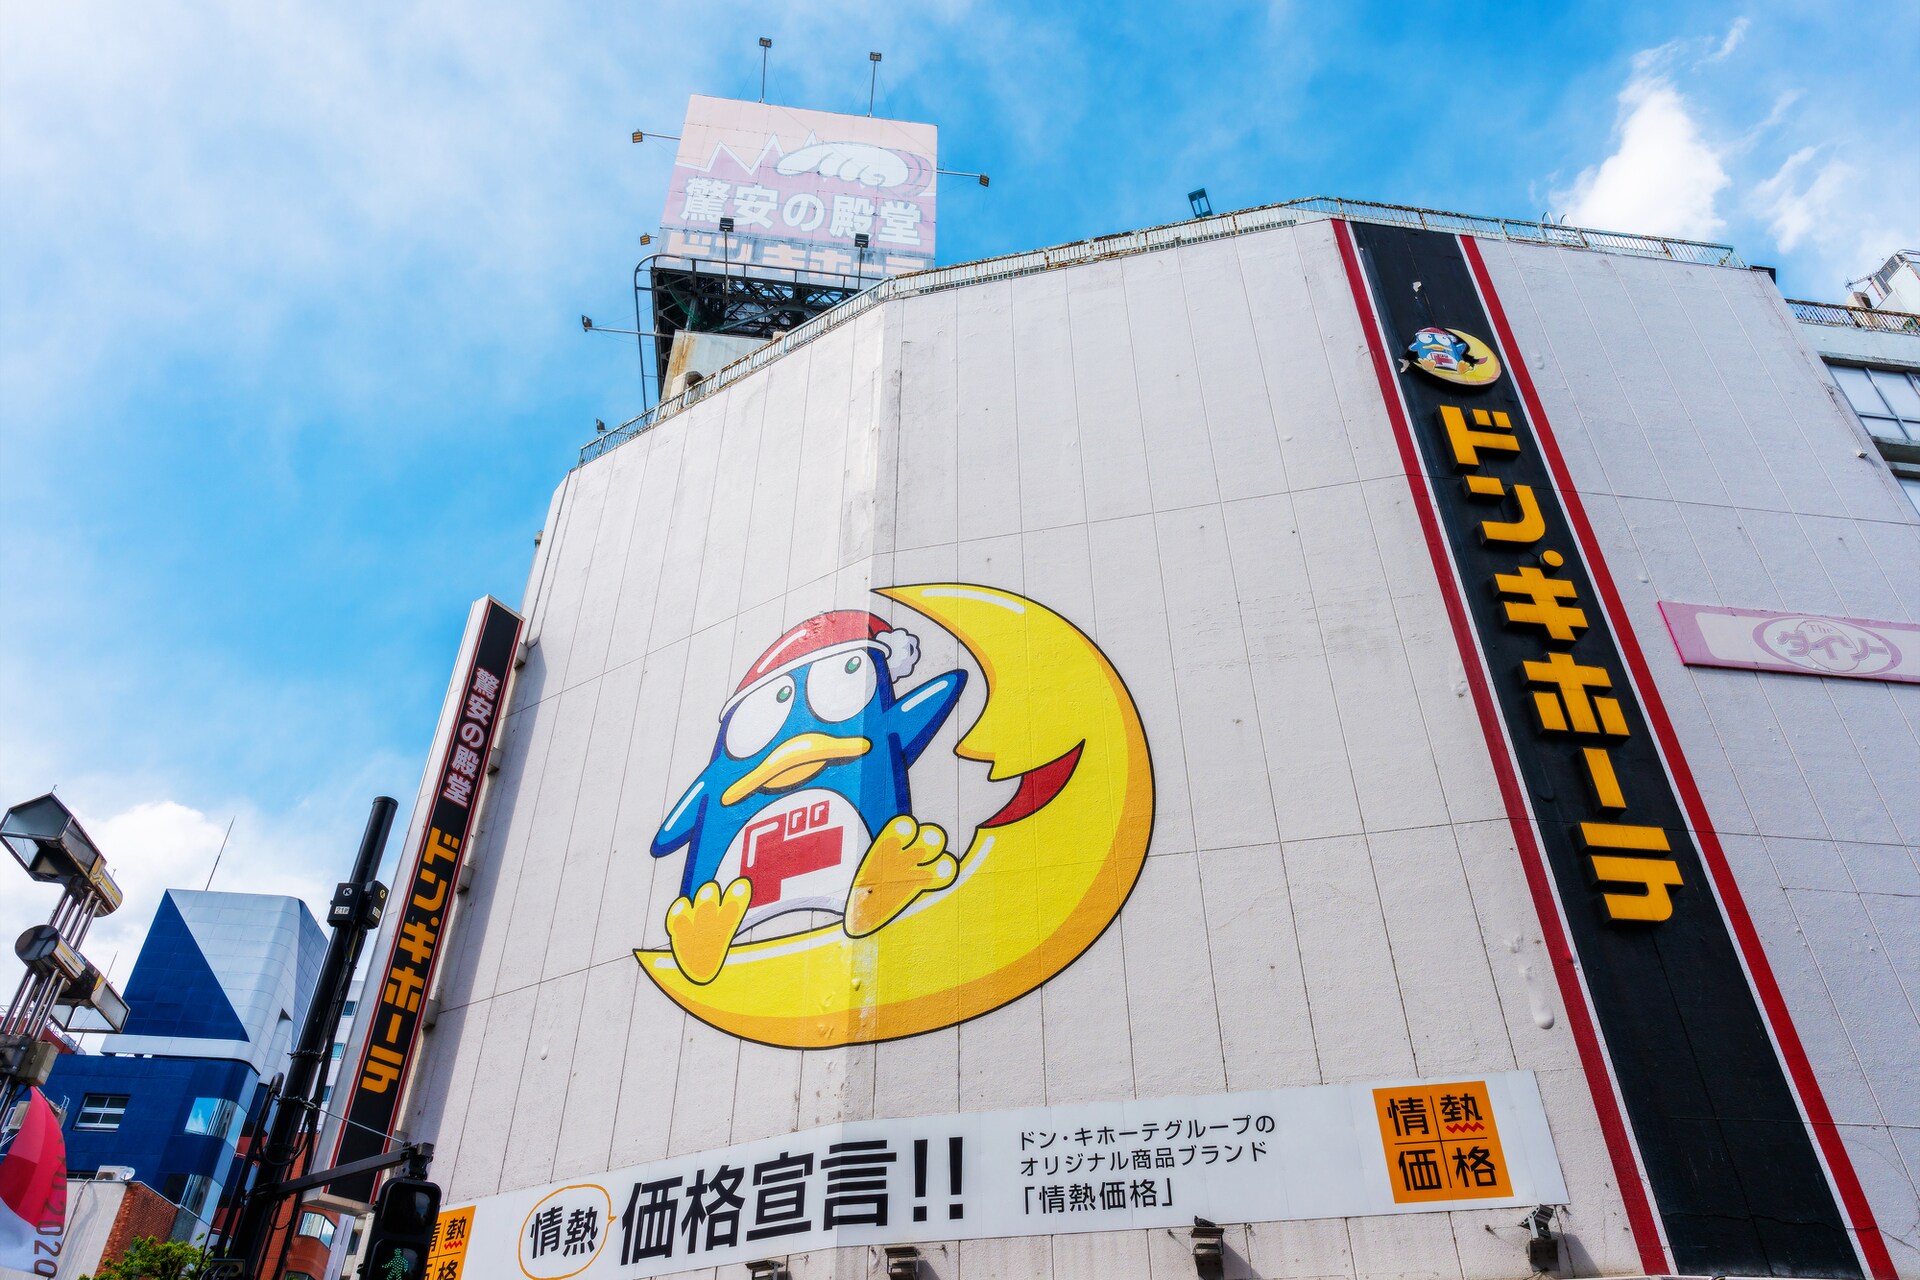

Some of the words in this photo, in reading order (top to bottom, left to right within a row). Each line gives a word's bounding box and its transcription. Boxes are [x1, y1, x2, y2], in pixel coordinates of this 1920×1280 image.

[680, 176, 922, 246] 驚安の殿堂
[1807, 623, 1834, 635] The
[1437, 403, 1685, 923] ドン・キホーテ
[441, 666, 500, 809] 驚安の殿堂
[360, 826, 461, 1094] ドン・キホーテ
[1020, 1114, 1276, 1151] ドン・キホーテグループの
[1386, 1092, 1485, 1137] 情熱
[1020, 1141, 1268, 1177] オリジナル商品ブランド
[1397, 1145, 1498, 1192] 価格
[1023, 1177, 1175, 1215] 「情熱価格」
[529, 1205, 599, 1260] 情熱
